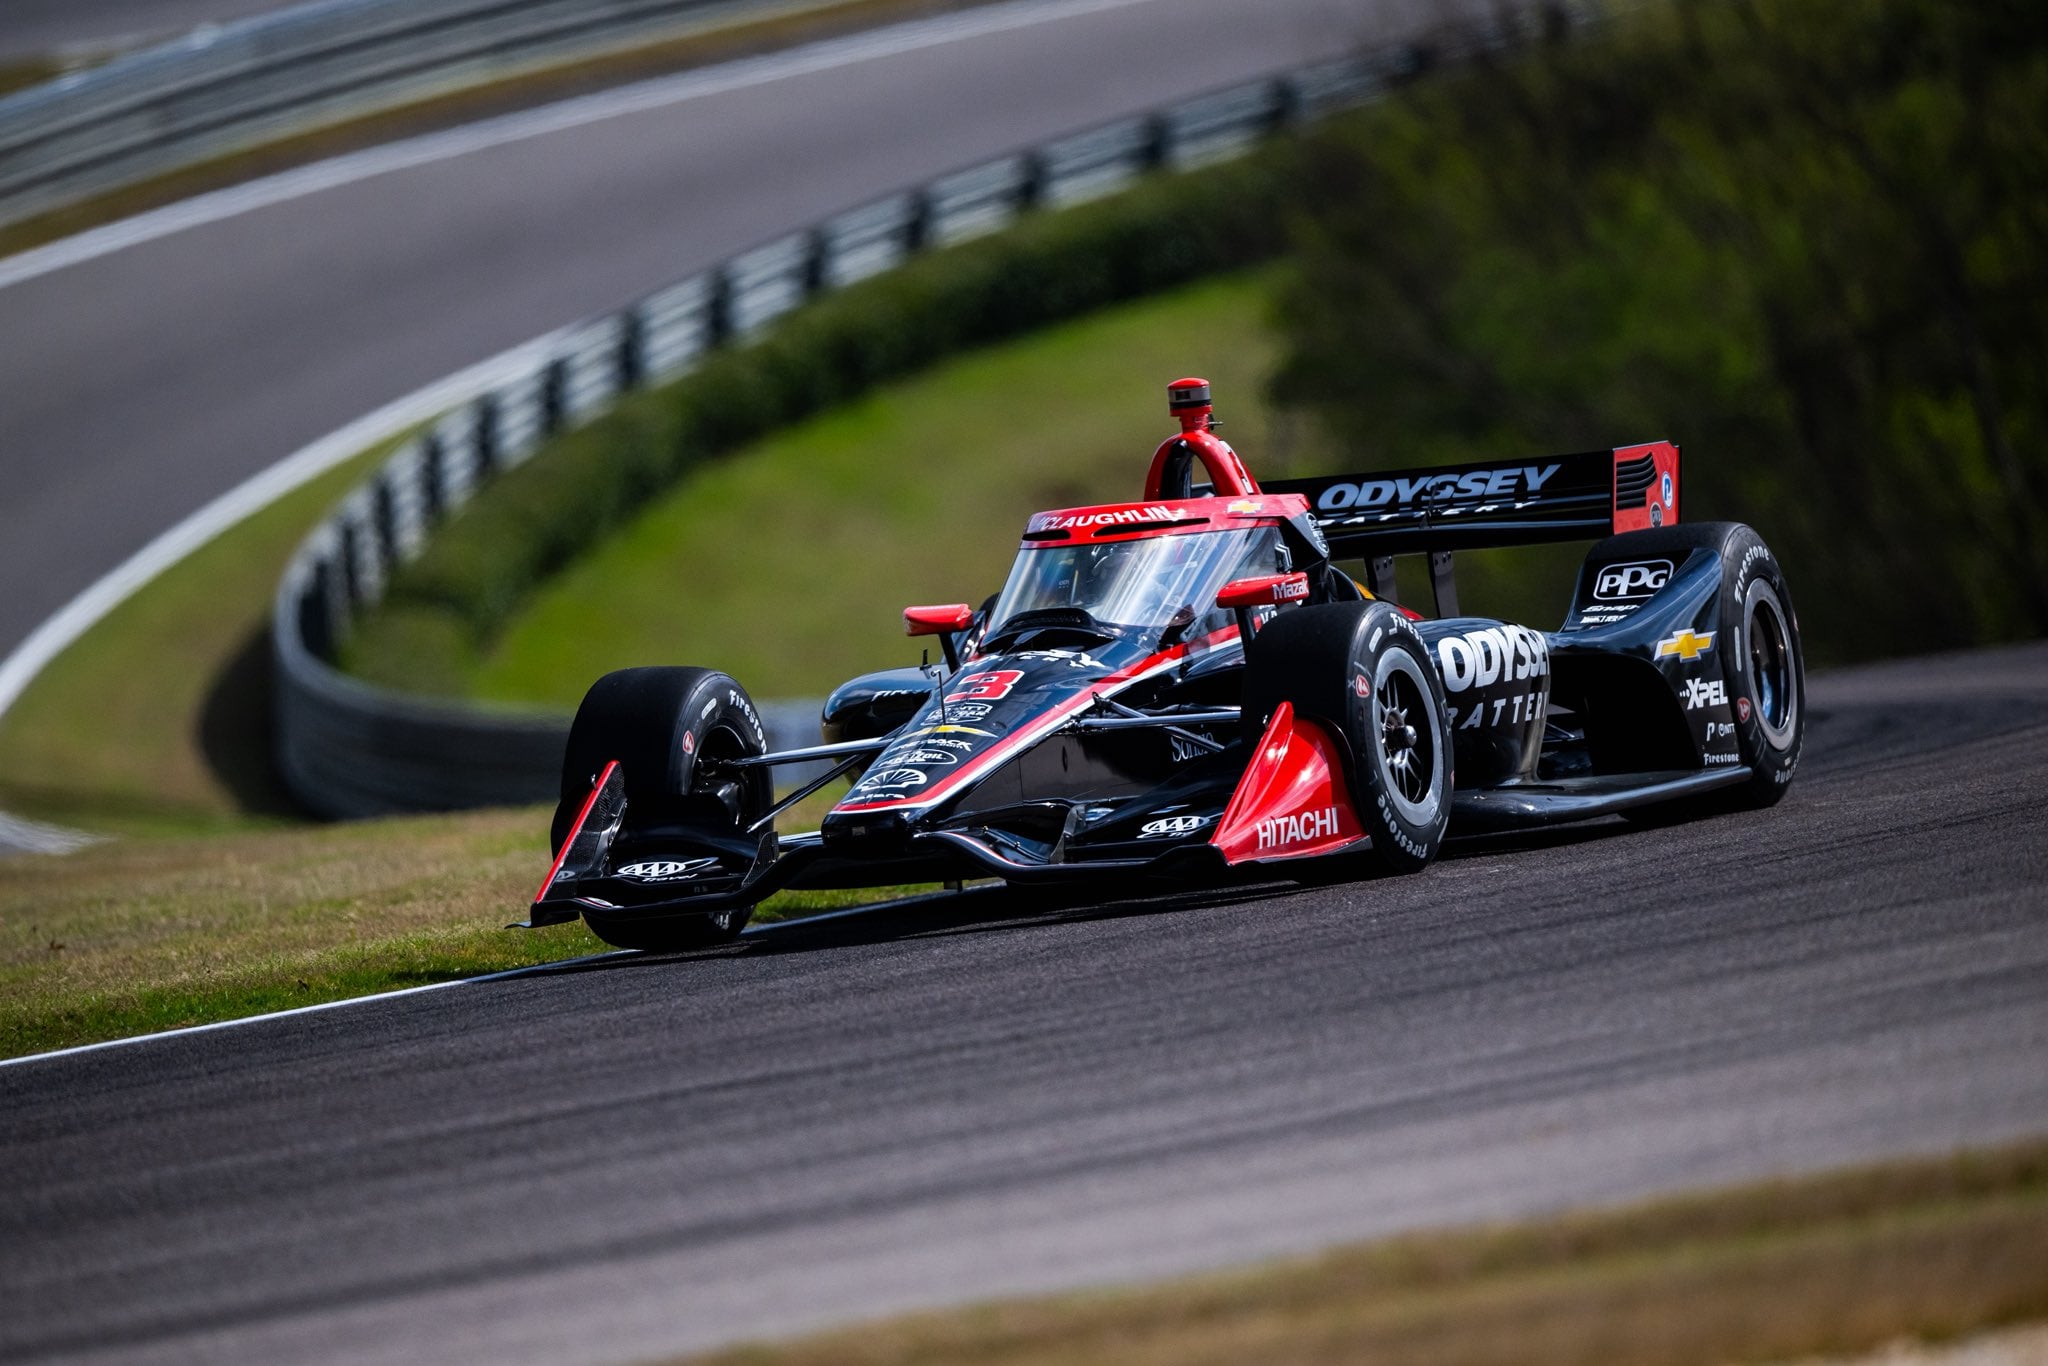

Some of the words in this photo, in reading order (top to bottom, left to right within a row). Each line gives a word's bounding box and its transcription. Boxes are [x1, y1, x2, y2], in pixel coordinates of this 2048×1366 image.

[1317, 463, 1562, 510] ODYSSEY
[1272, 578, 1308, 600] Mazak
[1600, 566, 1668, 596] PPG
[1438, 624, 1550, 692] ODYSSE
[944, 670, 1025, 703] 3
[1686, 677, 1728, 710] XPEL
[729, 689, 767, 755] Fireston
[1702, 753, 1740, 766] Firestone
[1256, 806, 1339, 849] HITACHI
[1377, 794, 1428, 860] Firestone
[620, 861, 684, 877] AAA
